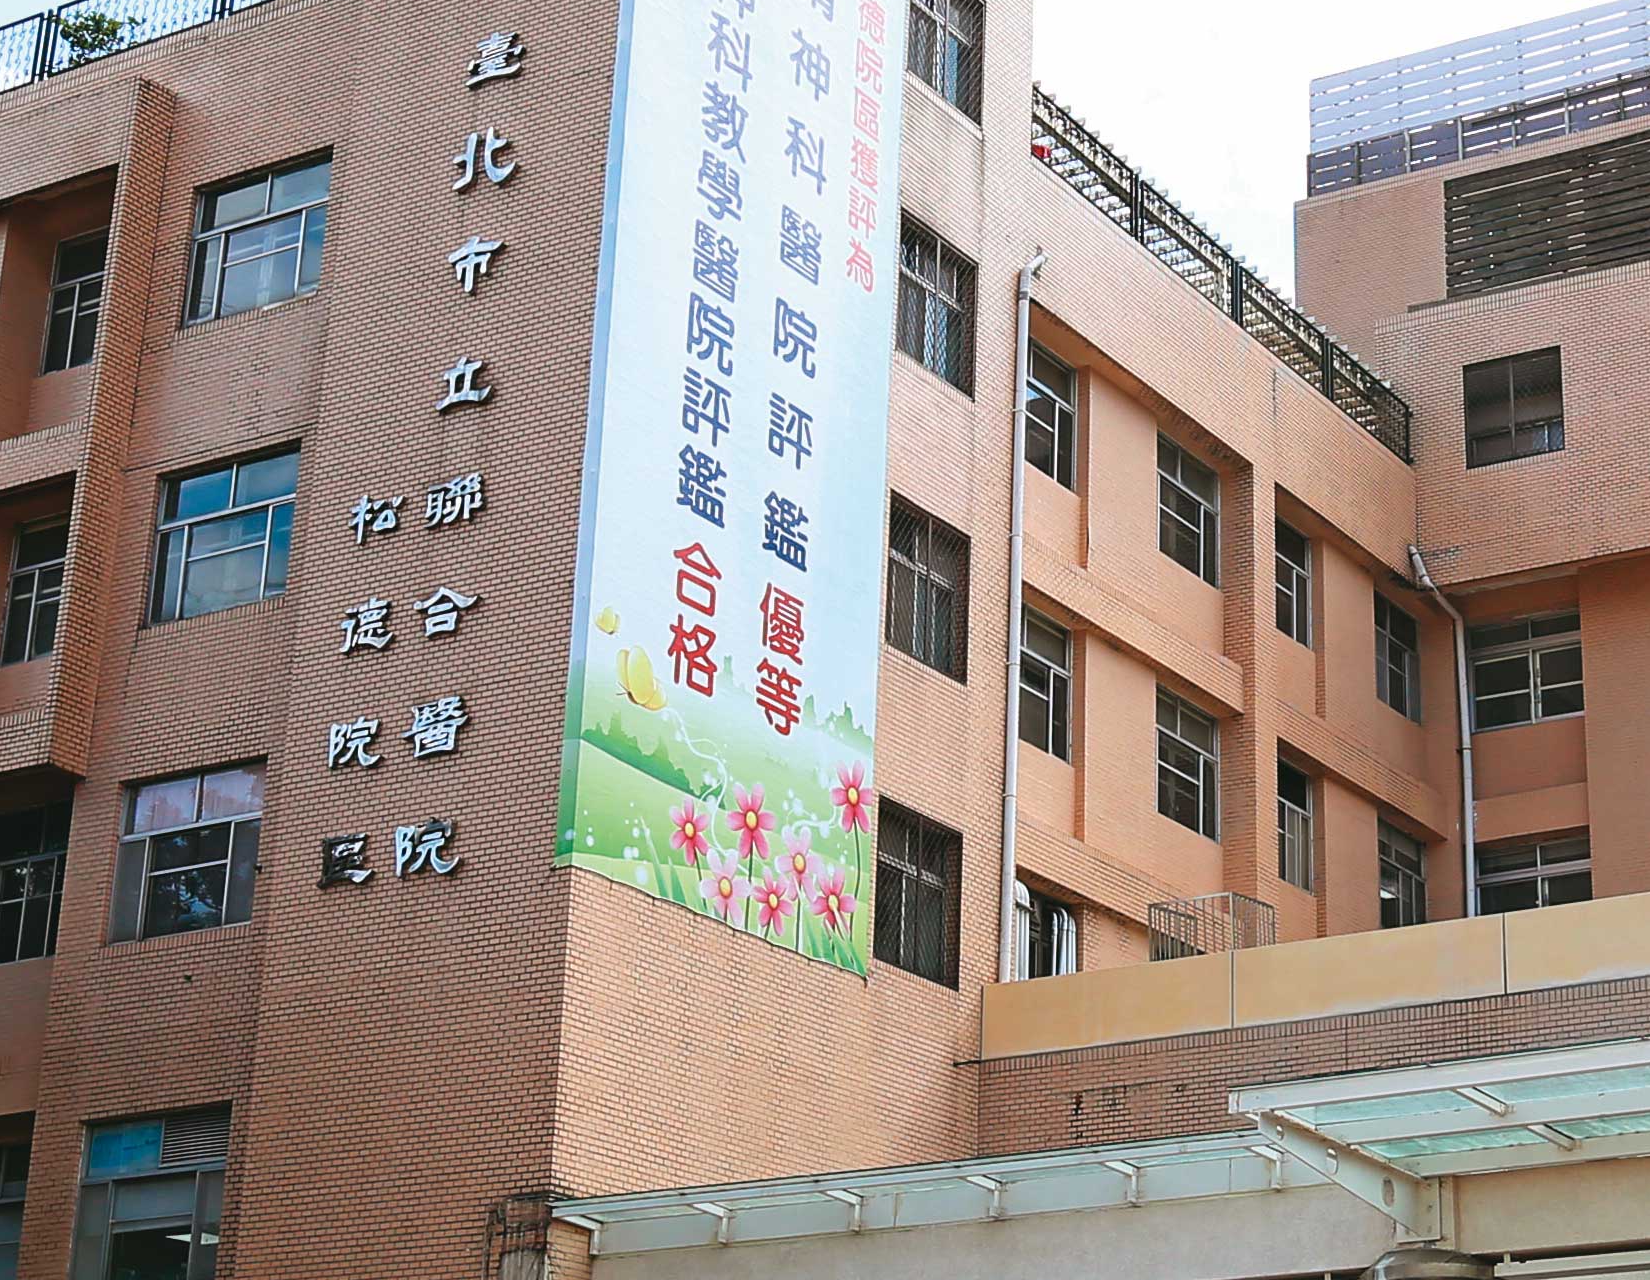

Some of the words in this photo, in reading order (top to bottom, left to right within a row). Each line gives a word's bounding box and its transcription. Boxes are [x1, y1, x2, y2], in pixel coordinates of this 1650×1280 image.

[315, 493, 407, 891] 松德院區
[394, 31, 526, 880] 臺北市立聯合醫院
